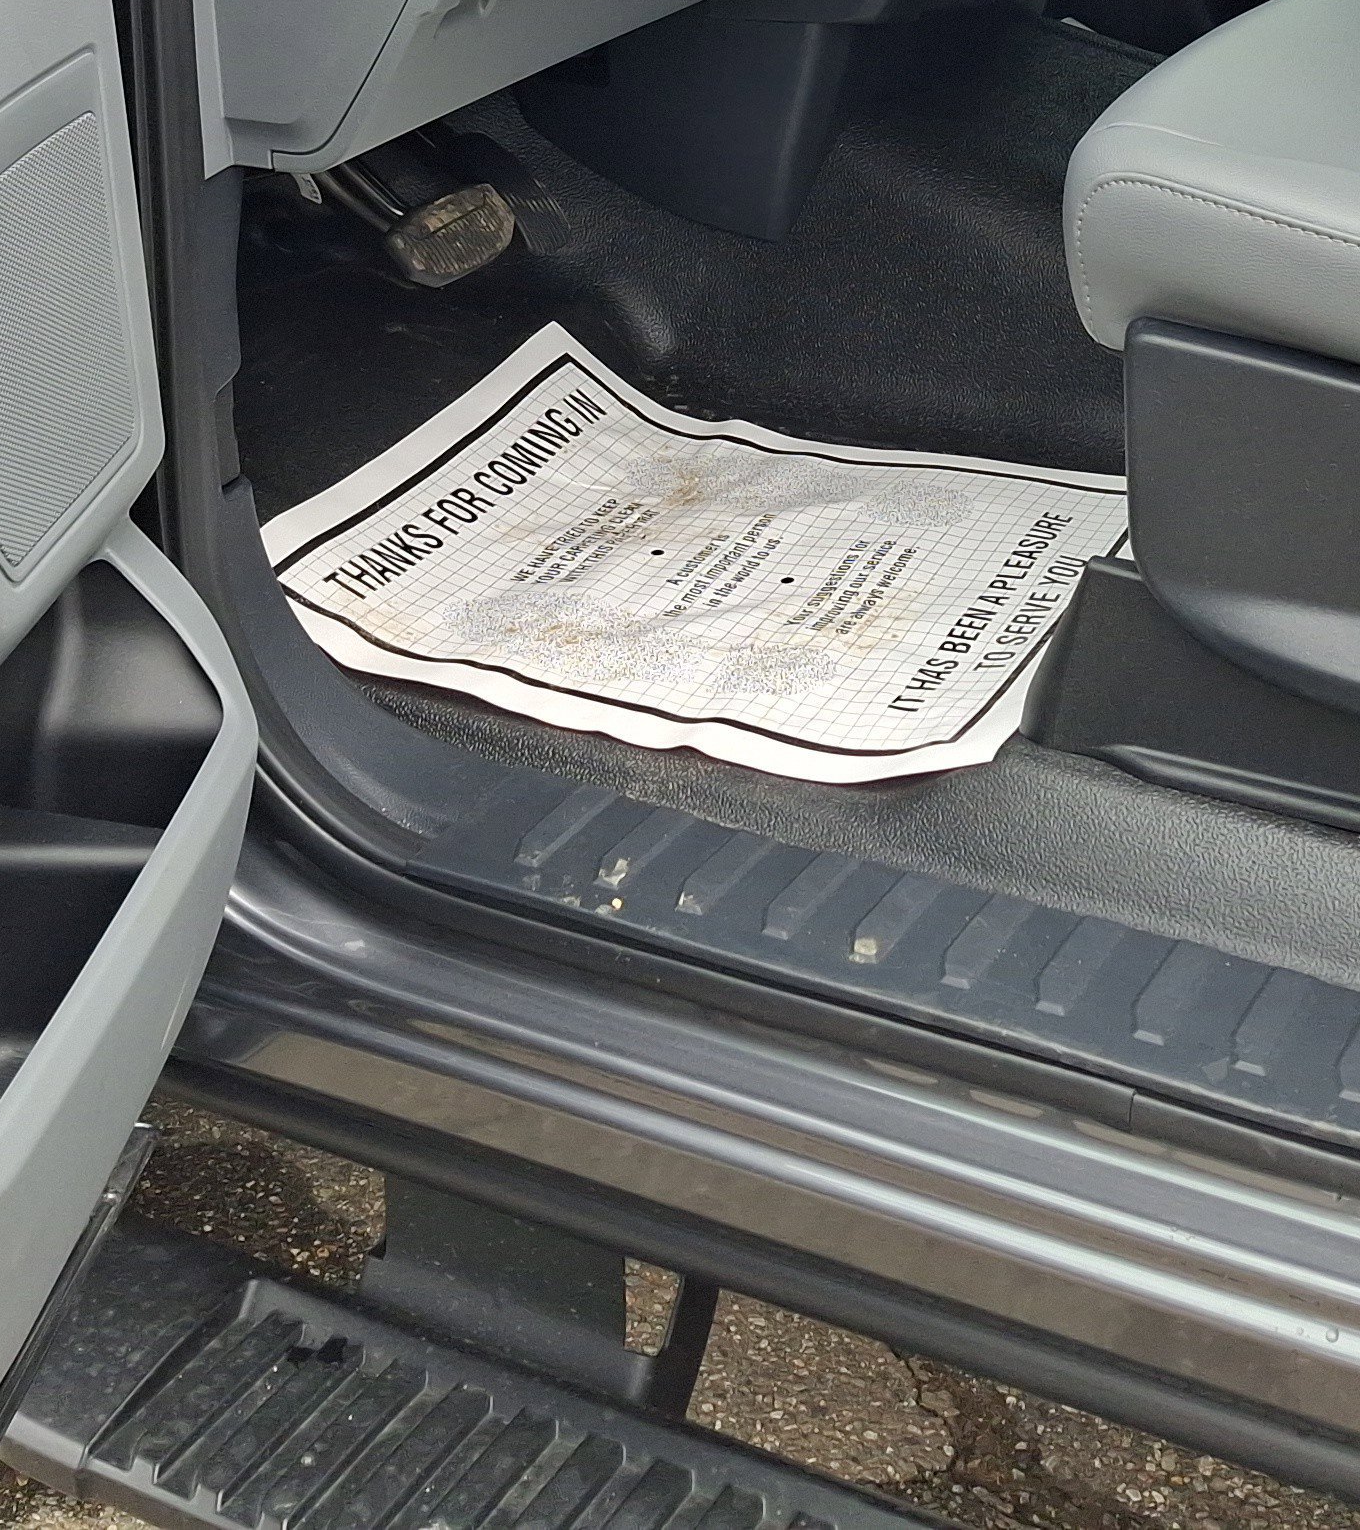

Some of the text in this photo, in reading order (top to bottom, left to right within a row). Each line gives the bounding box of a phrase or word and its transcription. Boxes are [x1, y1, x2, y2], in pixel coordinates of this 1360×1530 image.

[323, 388, 607, 599] THANKS FOR COMING IN
[510, 498, 620, 583] WE HAVE TRIED TO KEEP
[532, 563, 566, 585] YOUR
[611, 501, 645, 525] CLEAN
[559, 561, 592, 583] WITH
[583, 545, 614, 568] THIS
[662, 513, 778, 618] the most important person
[666, 578, 684, 586] A
[677, 542, 722, 578] customer
[703, 598, 722, 608] in
[714, 582, 738, 598] the
[731, 560, 760, 583] world
[752, 551, 770, 560] to
[783, 540, 871, 626] Your suggestions for
[805, 540, 898, 632] improving our service
[835, 620, 857, 635] are
[850, 588, 885, 620] always
[887, 511, 1074, 713] IT HAS BEEN A PLEASURE
[973, 555, 1088, 672] TO SERVE YOU
